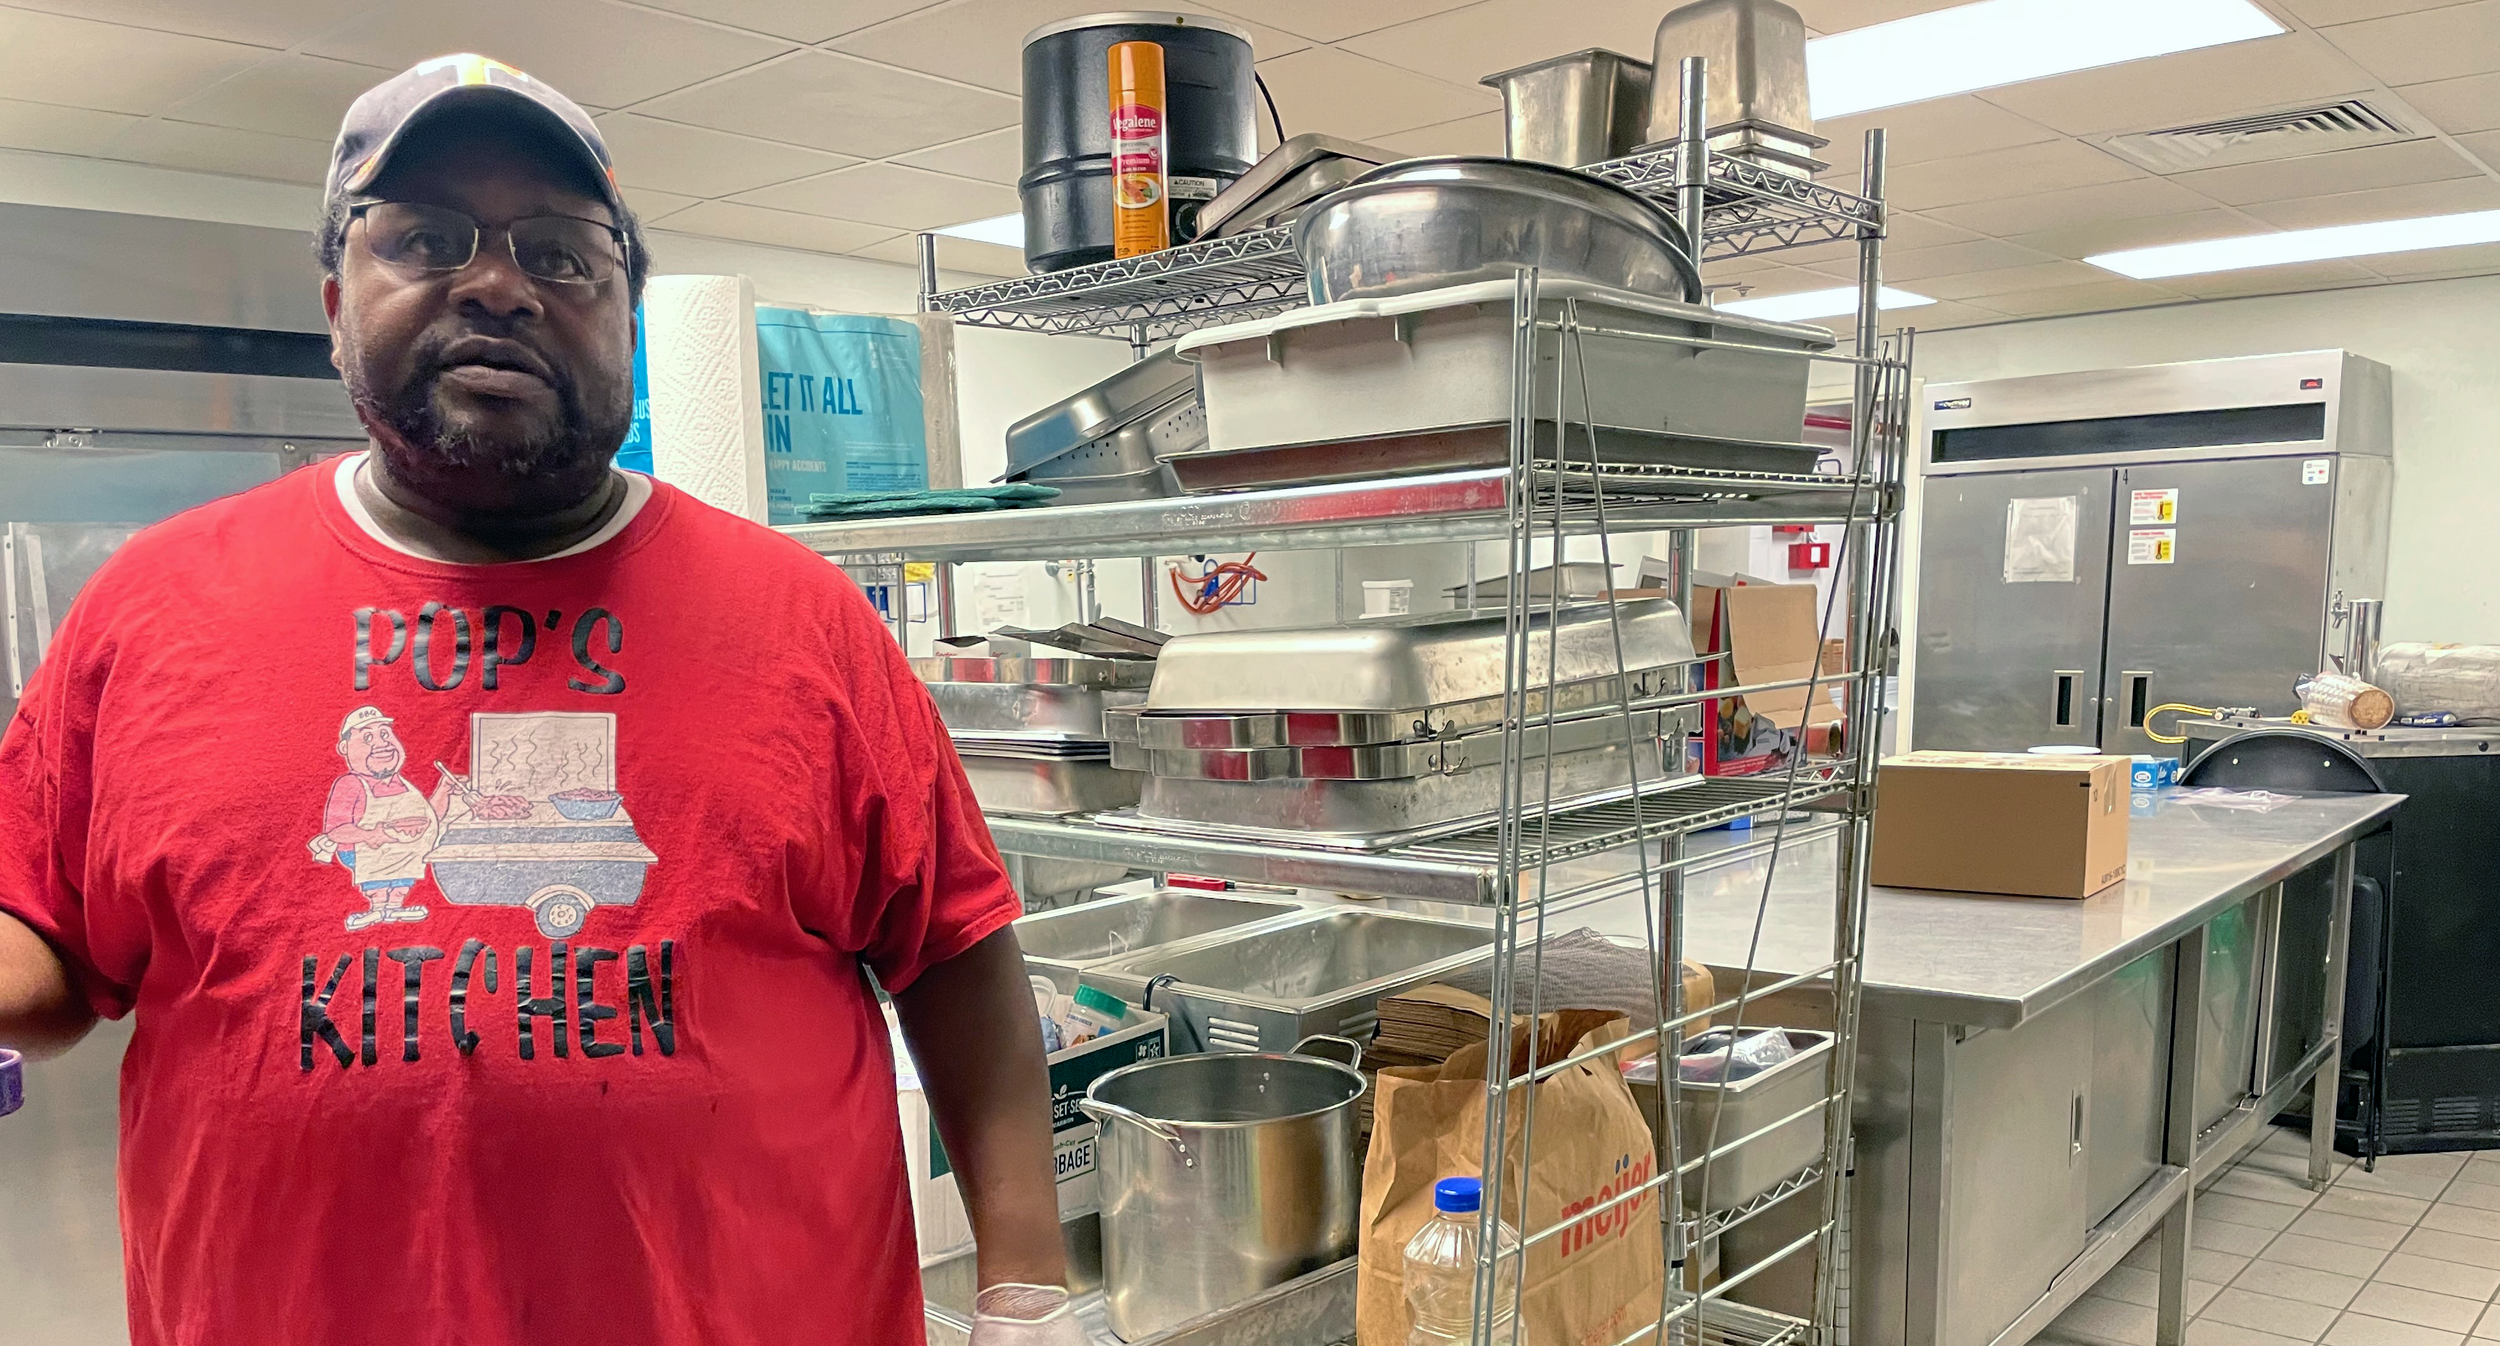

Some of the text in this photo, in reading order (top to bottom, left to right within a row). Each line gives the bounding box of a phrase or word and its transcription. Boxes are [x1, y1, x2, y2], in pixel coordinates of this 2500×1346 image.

[1113, 115, 1156, 131] Vegalene
[1179, 179, 1205, 187] CAUTION
[762, 372, 863, 415] ET IT ALL
[767, 414, 792, 452] IN
[769, 458, 826, 473] HAPPY ACCIDENTS
[2123, 469, 2128, 485] 4
[353, 601, 626, 694] POP'S
[359, 709, 377, 719] BBQ
[300, 938, 675, 1071] KITCHEN
[1561, 1151, 1652, 1259] meijer
